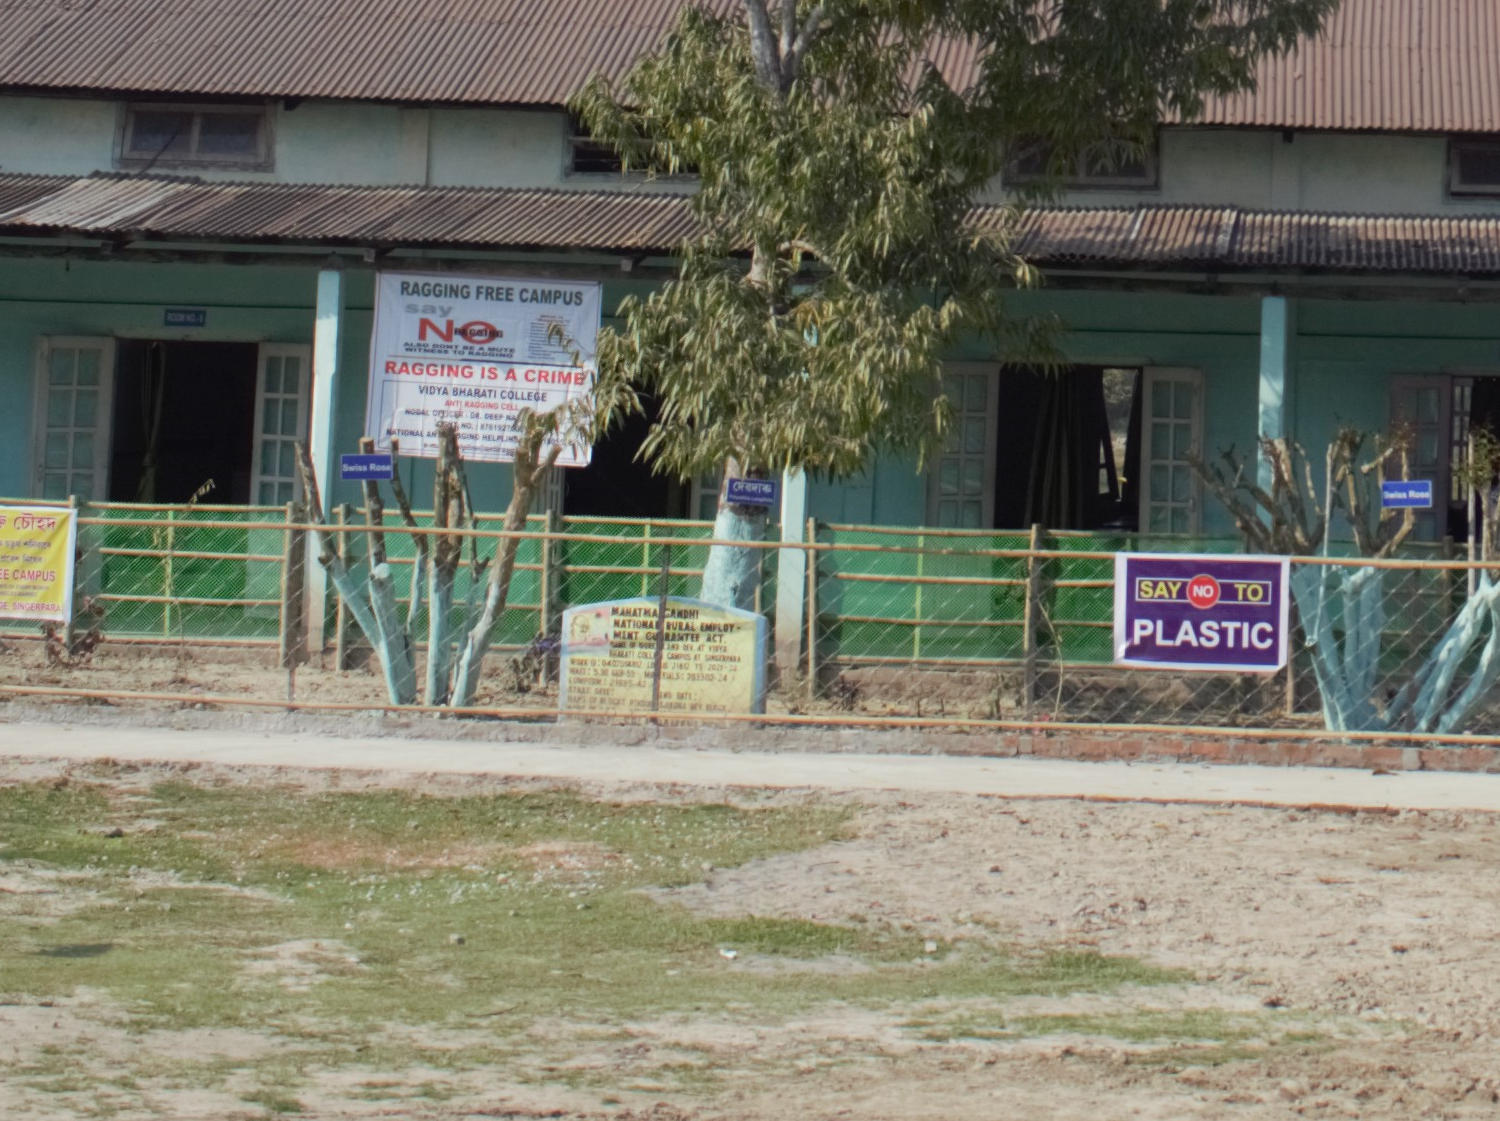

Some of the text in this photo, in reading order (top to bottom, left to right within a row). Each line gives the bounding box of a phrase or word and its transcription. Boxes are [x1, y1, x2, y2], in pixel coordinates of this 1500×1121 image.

[400, 281, 583, 306] RAGGING FREE CAMPUS
[405, 303, 453, 318] say
[403, 341, 430, 350] ALSO
[488, 346, 515, 354] MUTE
[404, 347, 449, 355] WITNESS
[468, 350, 514, 359] RAGGING
[385, 361, 586, 386] RAGGING IS A CRIME
[419, 384, 547, 402] VIDYA BHARATI COLLEGE
[444, 400, 518, 410] ANTI RAGGING CELL
[405, 408, 429, 416] NODAL
[485, 413, 504, 421] DEEP
[387, 429, 423, 438] NATIONAL
[343, 463, 391, 471] Swiss Rose
[1383, 490, 1430, 499] Swiss Rose
[12, 569, 56, 582] CAMPUS
[1140, 581, 1263, 602] SAY NO TO
[611, 606, 699, 619] MAHATMA GANDHI
[667, 620, 696, 631] RURAL
[645, 632, 700, 642] GURANTEE
[1133, 619, 1273, 649] PLASTIC
